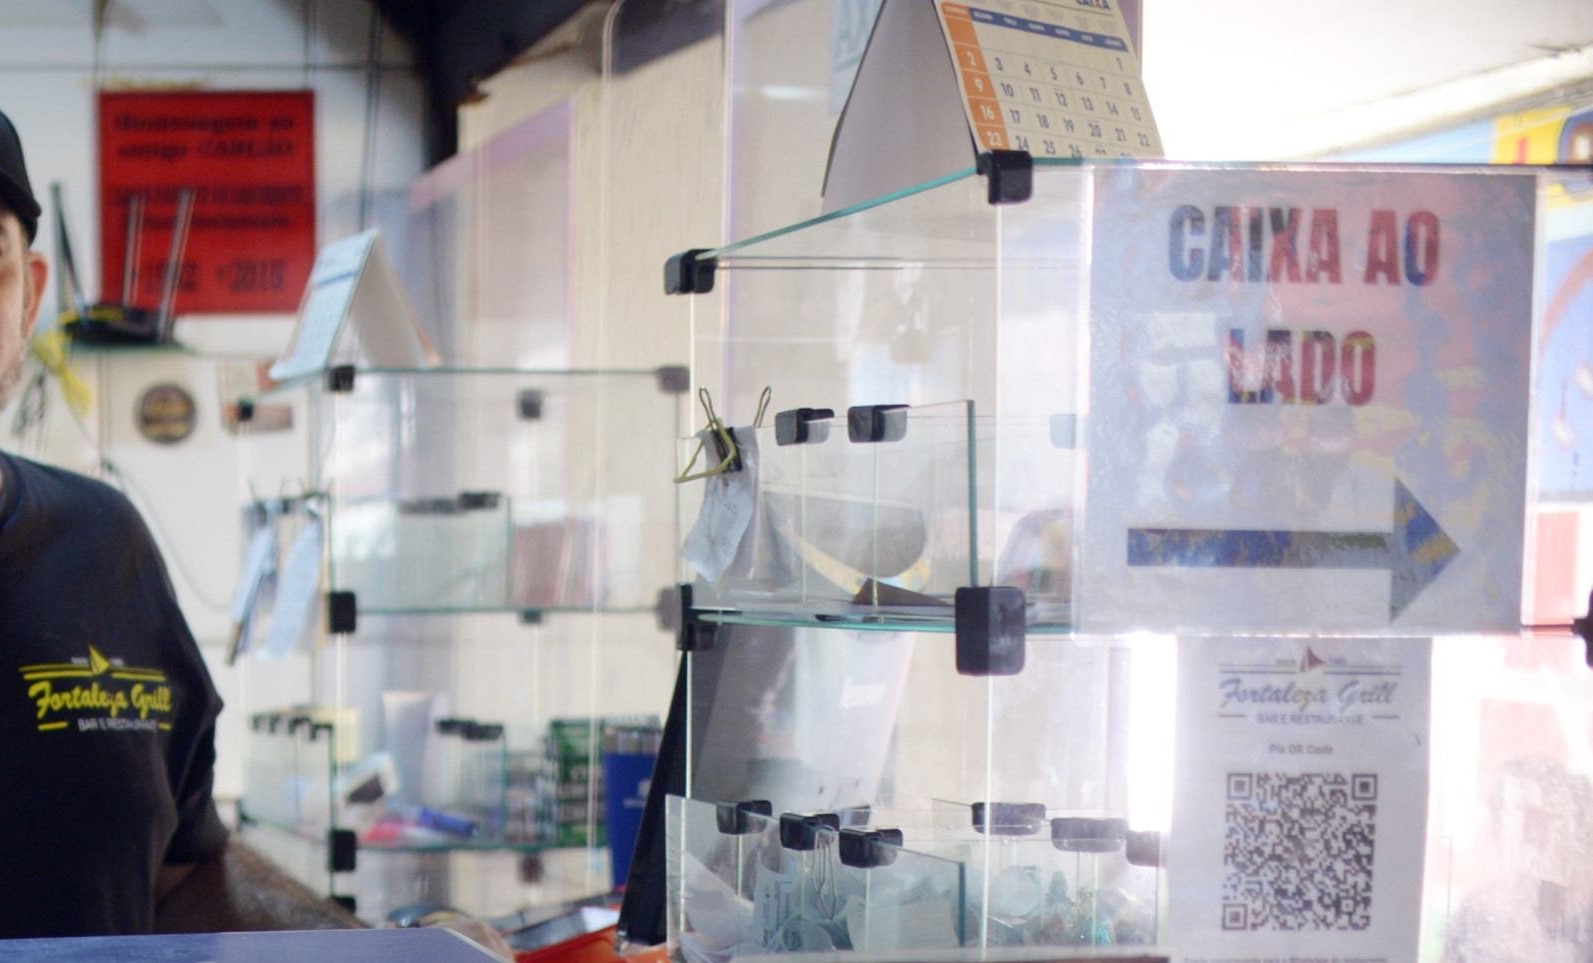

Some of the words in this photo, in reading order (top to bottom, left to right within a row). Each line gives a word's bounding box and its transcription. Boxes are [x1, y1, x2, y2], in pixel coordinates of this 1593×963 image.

[967, 52, 977, 66] 2
[994, 57, 1004, 71] 3
[1024, 62, 1032, 75] 4
[1050, 67, 1058, 80] 5
[1076, 72, 1084, 85] 6
[1099, 76, 1107, 89] 7
[1123, 83, 1132, 96] 8
[1116, 57, 1124, 71] 1
[974, 78, 984, 92] 9
[1000, 83, 1014, 97] 10
[1030, 88, 1041, 101] 11
[1055, 93, 1068, 107] 12
[1081, 97, 1094, 111] 13
[1106, 102, 1119, 116] 14
[1130, 107, 1141, 121] 15
[979, 105, 995, 120] 16
[1009, 109, 1022, 123] 17
[1036, 114, 1050, 129] 18
[1062, 119, 1075, 133] 19
[1088, 123, 1102, 137] 20
[1114, 128, 1126, 142] 21
[1137, 133, 1150, 147] 22
[986, 131, 1002, 147] 23
[1015, 135, 1030, 150] 24
[1042, 140, 1056, 154] 25
[1167, 204, 1344, 286] CAIXA
[1365, 209, 1440, 287] AO
[1227, 329, 1378, 407] LADO
[28, 680, 129, 720] Fortaleza
[130, 683, 172, 720] Grill
[1219, 678, 1327, 712] Fortaleza
[1337, 680, 1399, 713] Grill
[1256, 714, 1280, 725] BAR
[1280, 714, 1288, 724] E
[1289, 714, 1363, 726] RESTAURANTE
[1289, 744, 1304, 755] QR
[1307, 744, 1334, 754] Code
